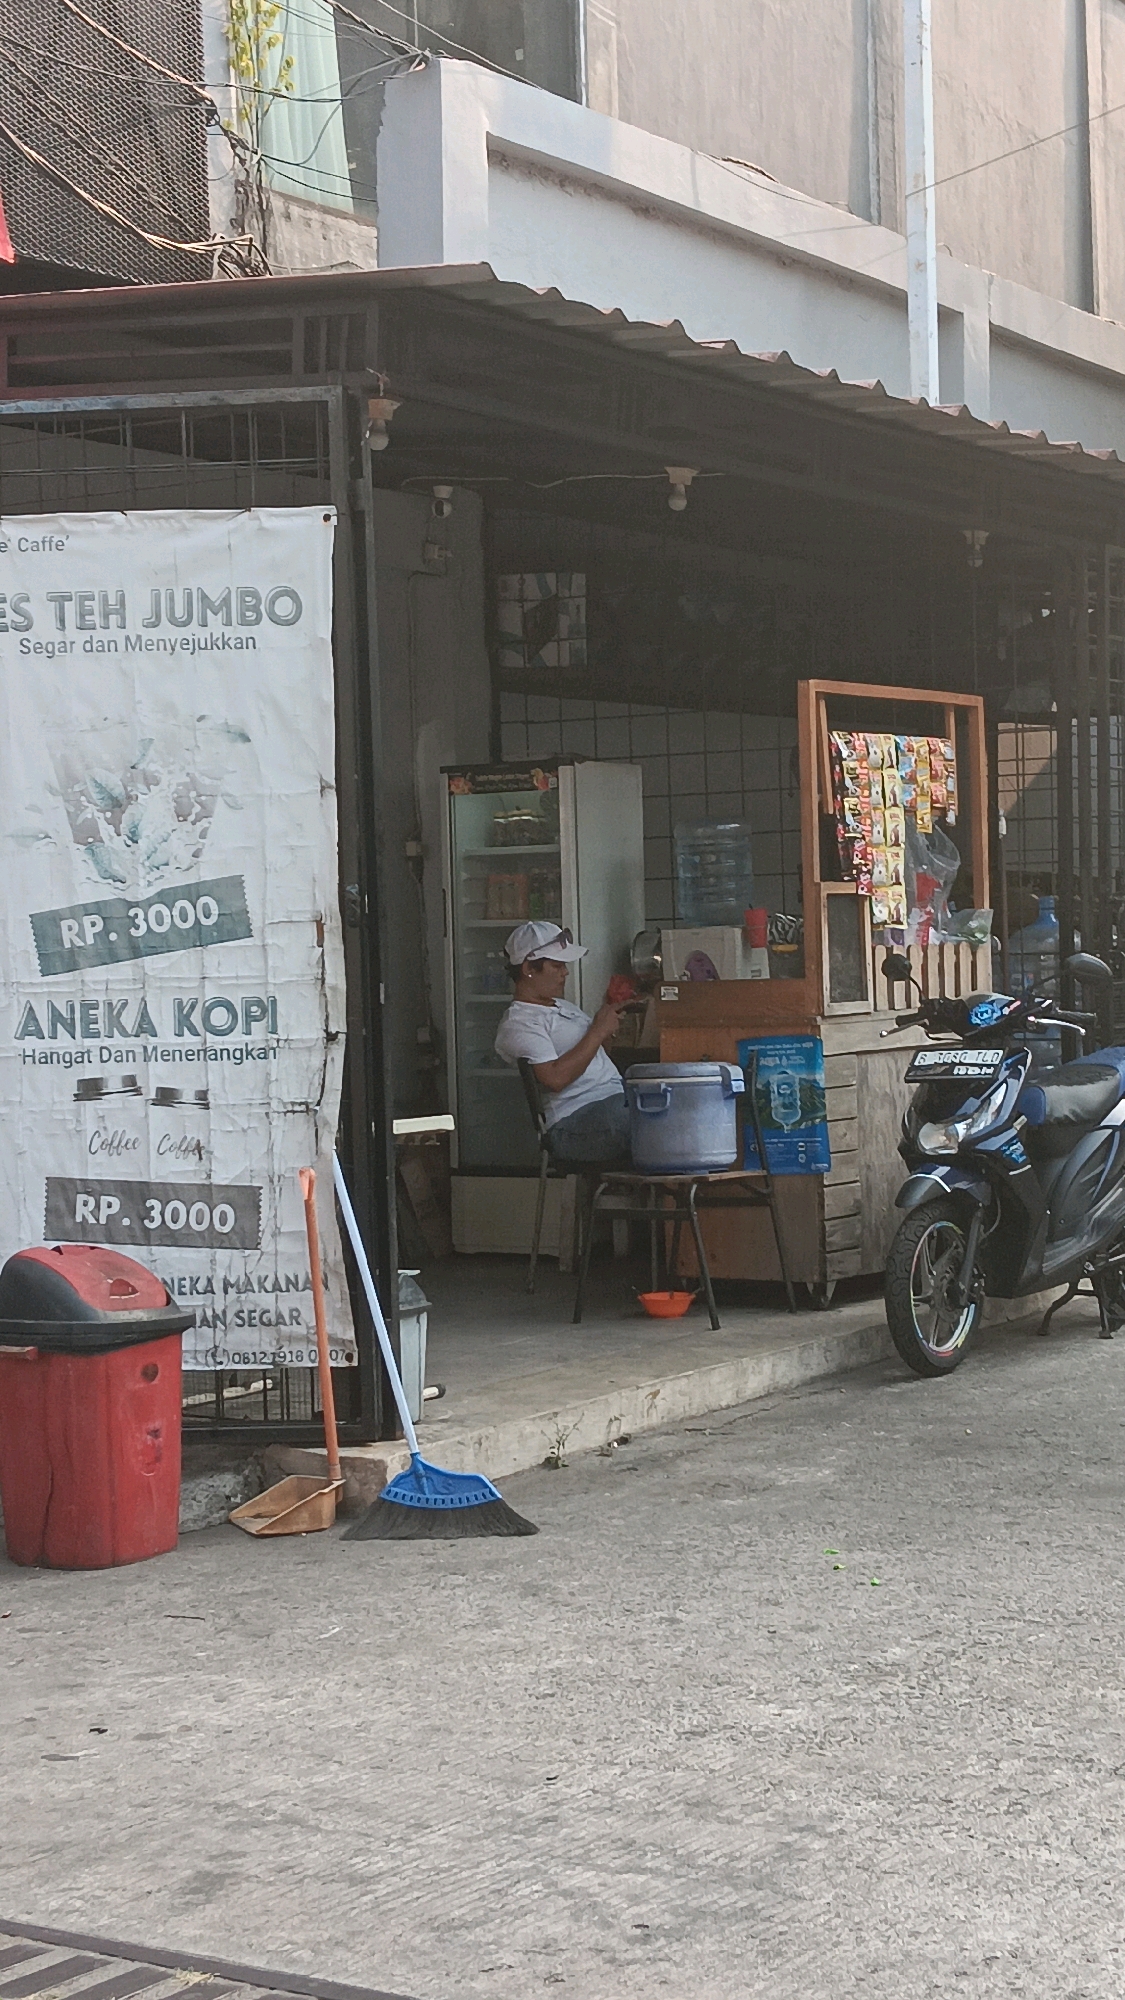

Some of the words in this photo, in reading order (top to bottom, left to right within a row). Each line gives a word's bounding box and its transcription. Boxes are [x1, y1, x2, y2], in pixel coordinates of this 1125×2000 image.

[46, 590, 127, 632] TEH
[142, 585, 303, 629] JUMBO
[19, 637, 76, 659] Segar
[83, 634, 118, 654] dan
[124, 632, 257, 656] Menyejukkan
[60, 914, 118, 949] RP.
[128, 895, 219, 938] 3000
[14, 997, 158, 1040] ANEKA
[173, 995, 278, 1038] KOPI
[22, 1047, 92, 1069] Hangat
[100, 1045, 136, 1064] Dan
[143, 1043, 277, 1066] Menenangkan
[89, 1129, 140, 1157] Coffee
[157, 1133, 205, 1160] Coffe
[75, 1193, 131, 1227] RP.
[143, 1199, 235, 1234] 3000
[160, 1275, 216, 1296] NEKA
[234, 1306, 302, 1328] SEGAR
